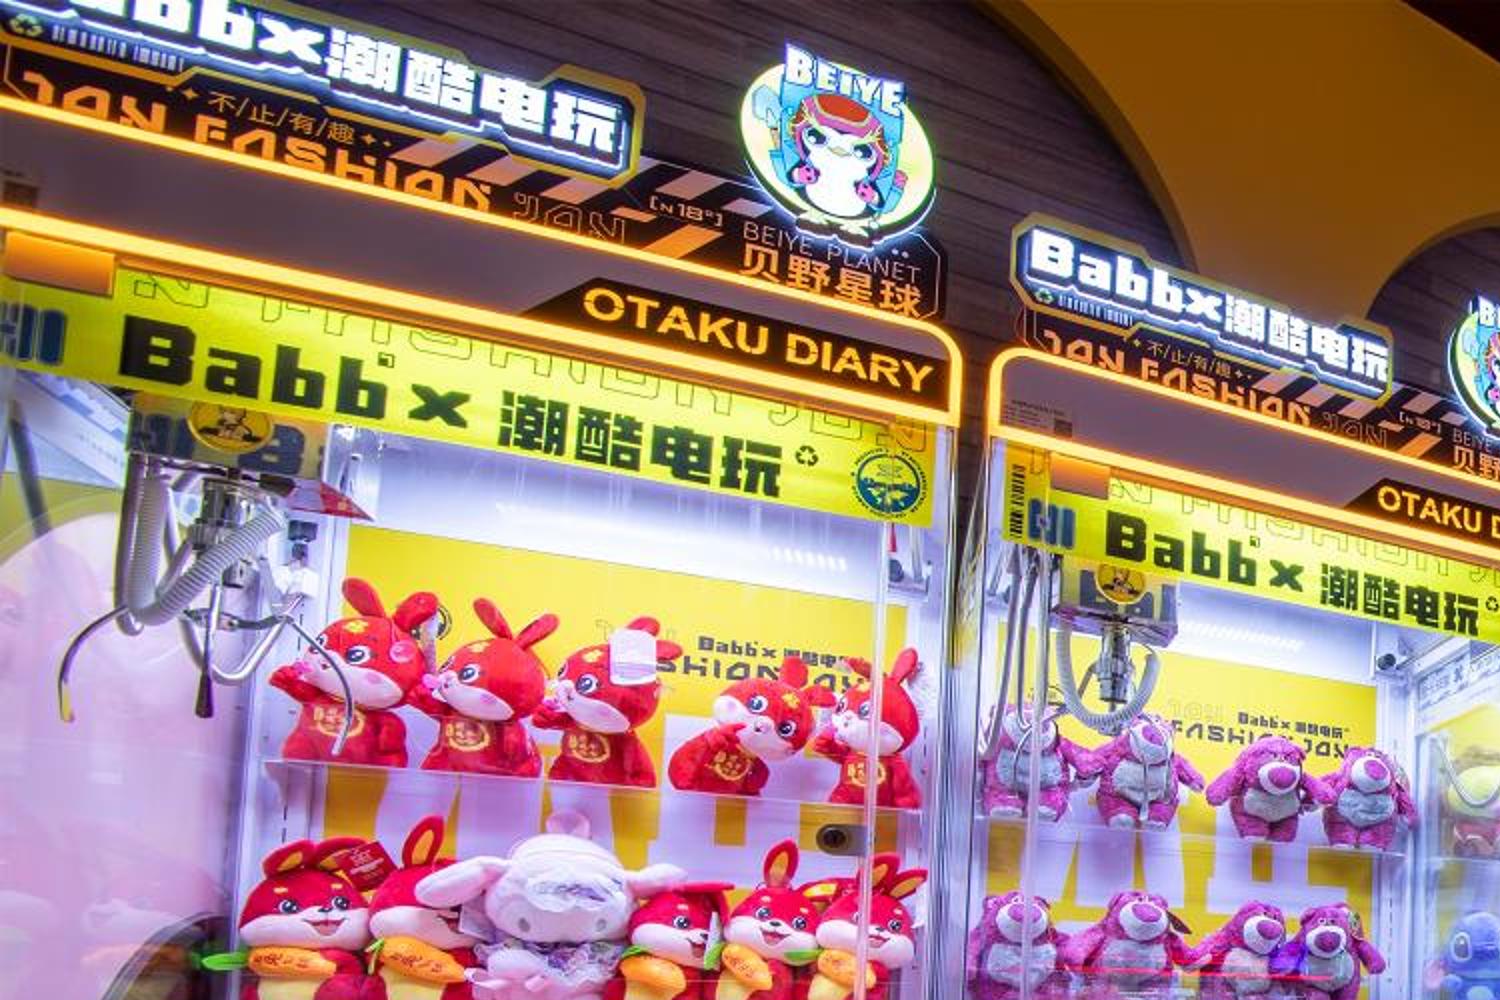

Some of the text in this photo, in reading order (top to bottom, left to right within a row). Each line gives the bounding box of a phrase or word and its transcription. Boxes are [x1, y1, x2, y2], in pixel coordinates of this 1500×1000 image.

[785, 44, 905, 117] BEIYE
[741, 244, 921, 318] 贝野星球
[743, 221, 921, 284] BEIYE PLANET
[583, 287, 769, 355] OTAKU
[786, 331, 935, 394] DIARY
[498, 389, 783, 497] 潮酷电玩
[1376, 485, 1482, 533] OTAKU
